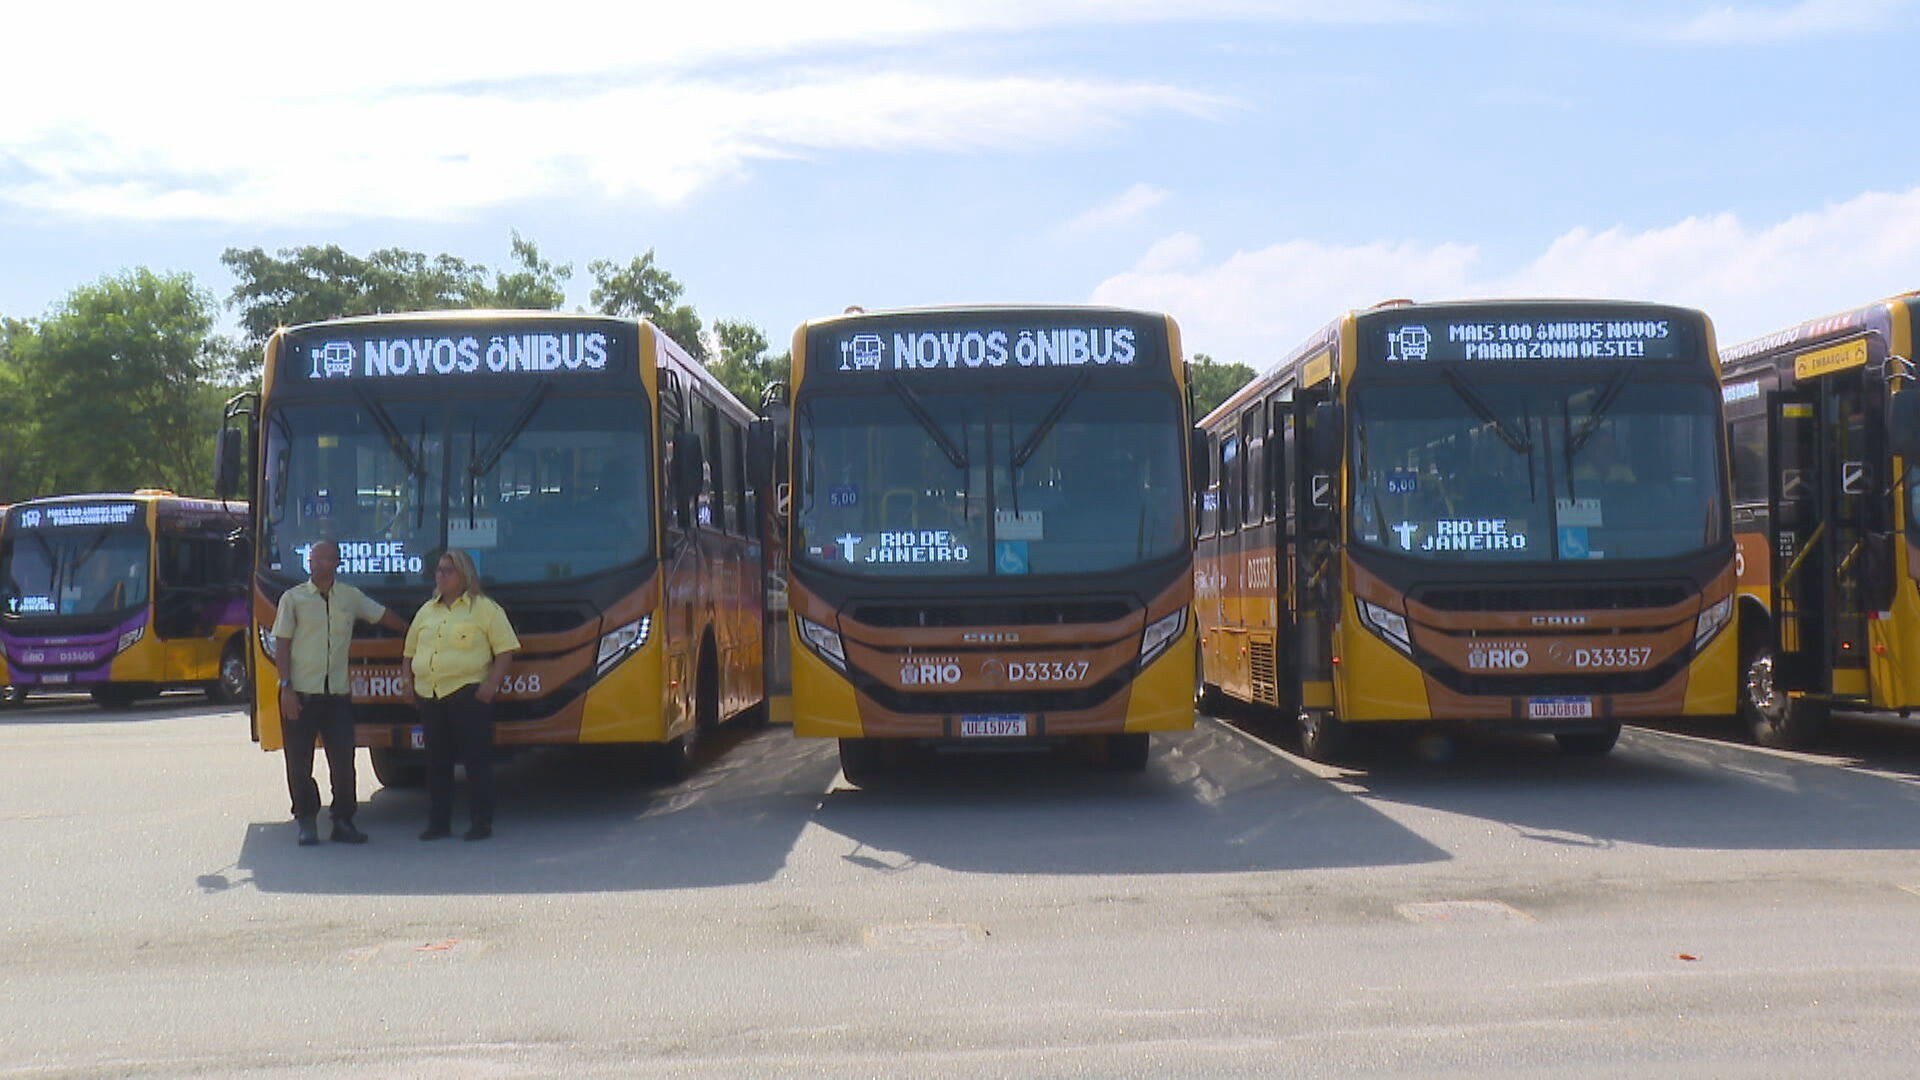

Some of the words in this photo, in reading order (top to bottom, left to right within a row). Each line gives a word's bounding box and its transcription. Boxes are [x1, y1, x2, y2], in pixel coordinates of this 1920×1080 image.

[1450, 324, 1494, 341] MAIS
[1499, 323, 1532, 340] 100
[1607, 321, 1668, 338] NOVOS
[364, 335, 480, 377] NOVOS
[894, 331, 1009, 370] NOVOS
[1437, 520, 1473, 535] RIO
[1477, 519, 1507, 534] DE
[881, 531, 916, 547] RIO
[920, 530, 949, 546] DE
[1421, 534, 1526, 550] JANEIRO
[338, 542, 372, 558] RIO
[376, 541, 404, 556] DE
[865, 546, 968, 563] JANEIRO
[336, 556, 422, 573] ANEIRO
[1488, 649, 1530, 669] RIO
[1575, 648, 1652, 668] D33357
[920, 664, 961, 684] RIO
[1008, 661, 1090, 681] D33367
[496, 674, 541, 694] 368
